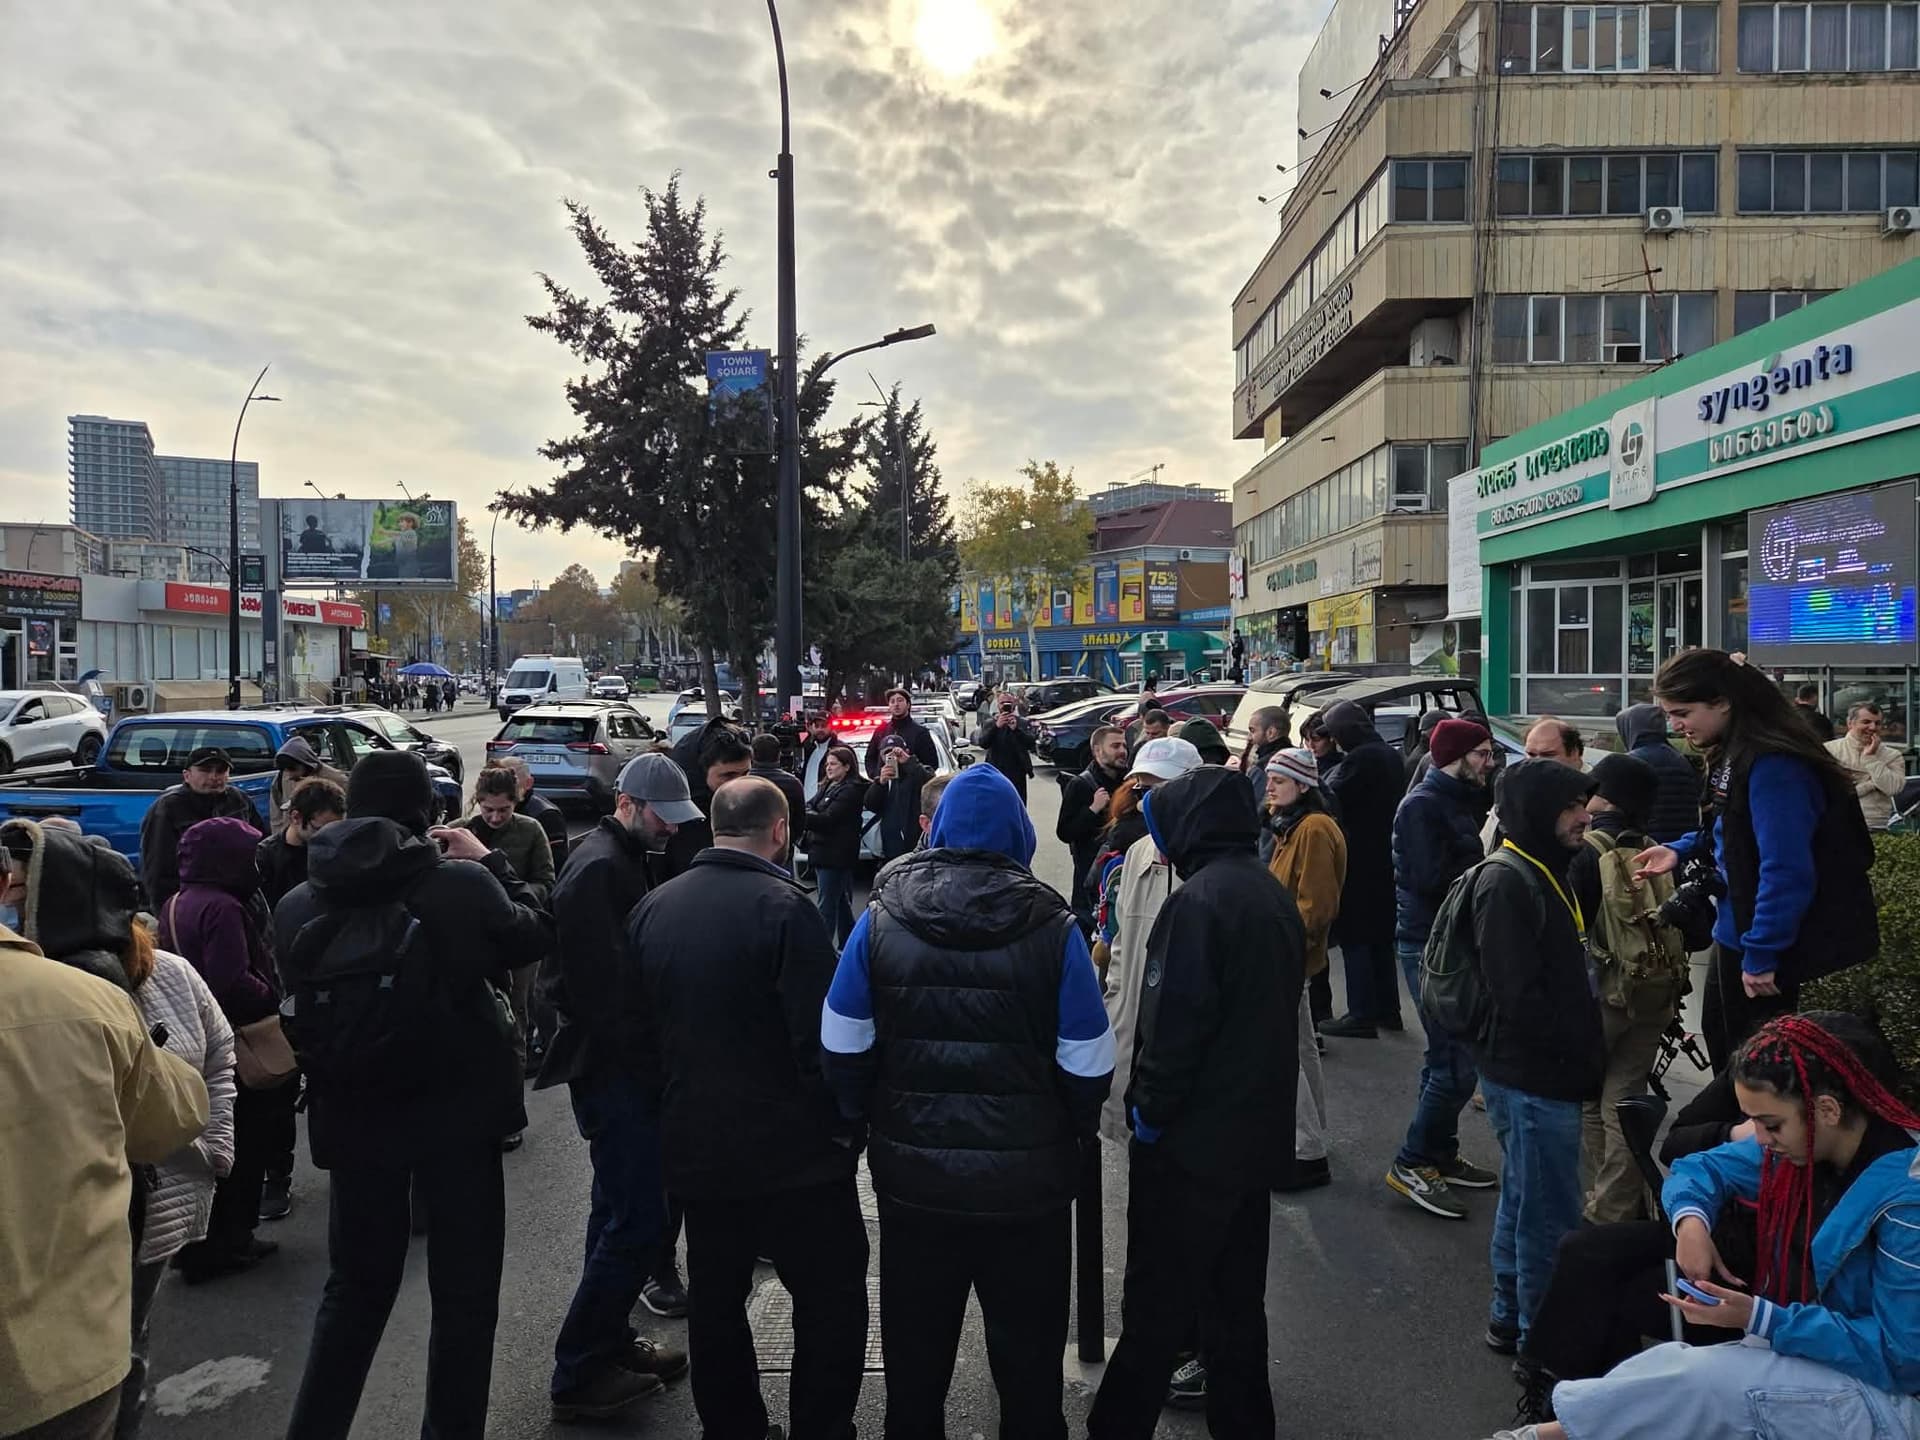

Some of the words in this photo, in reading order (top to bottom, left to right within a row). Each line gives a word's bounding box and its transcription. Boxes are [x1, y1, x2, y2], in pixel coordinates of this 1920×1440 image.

[722, 356, 753, 367] TOWN
[716, 366, 758, 377] SQUARE
[1698, 344, 1853, 424] syngenta
[1710, 405, 1834, 463] სინგენტა
[1148, 571, 1178, 586] 75%
